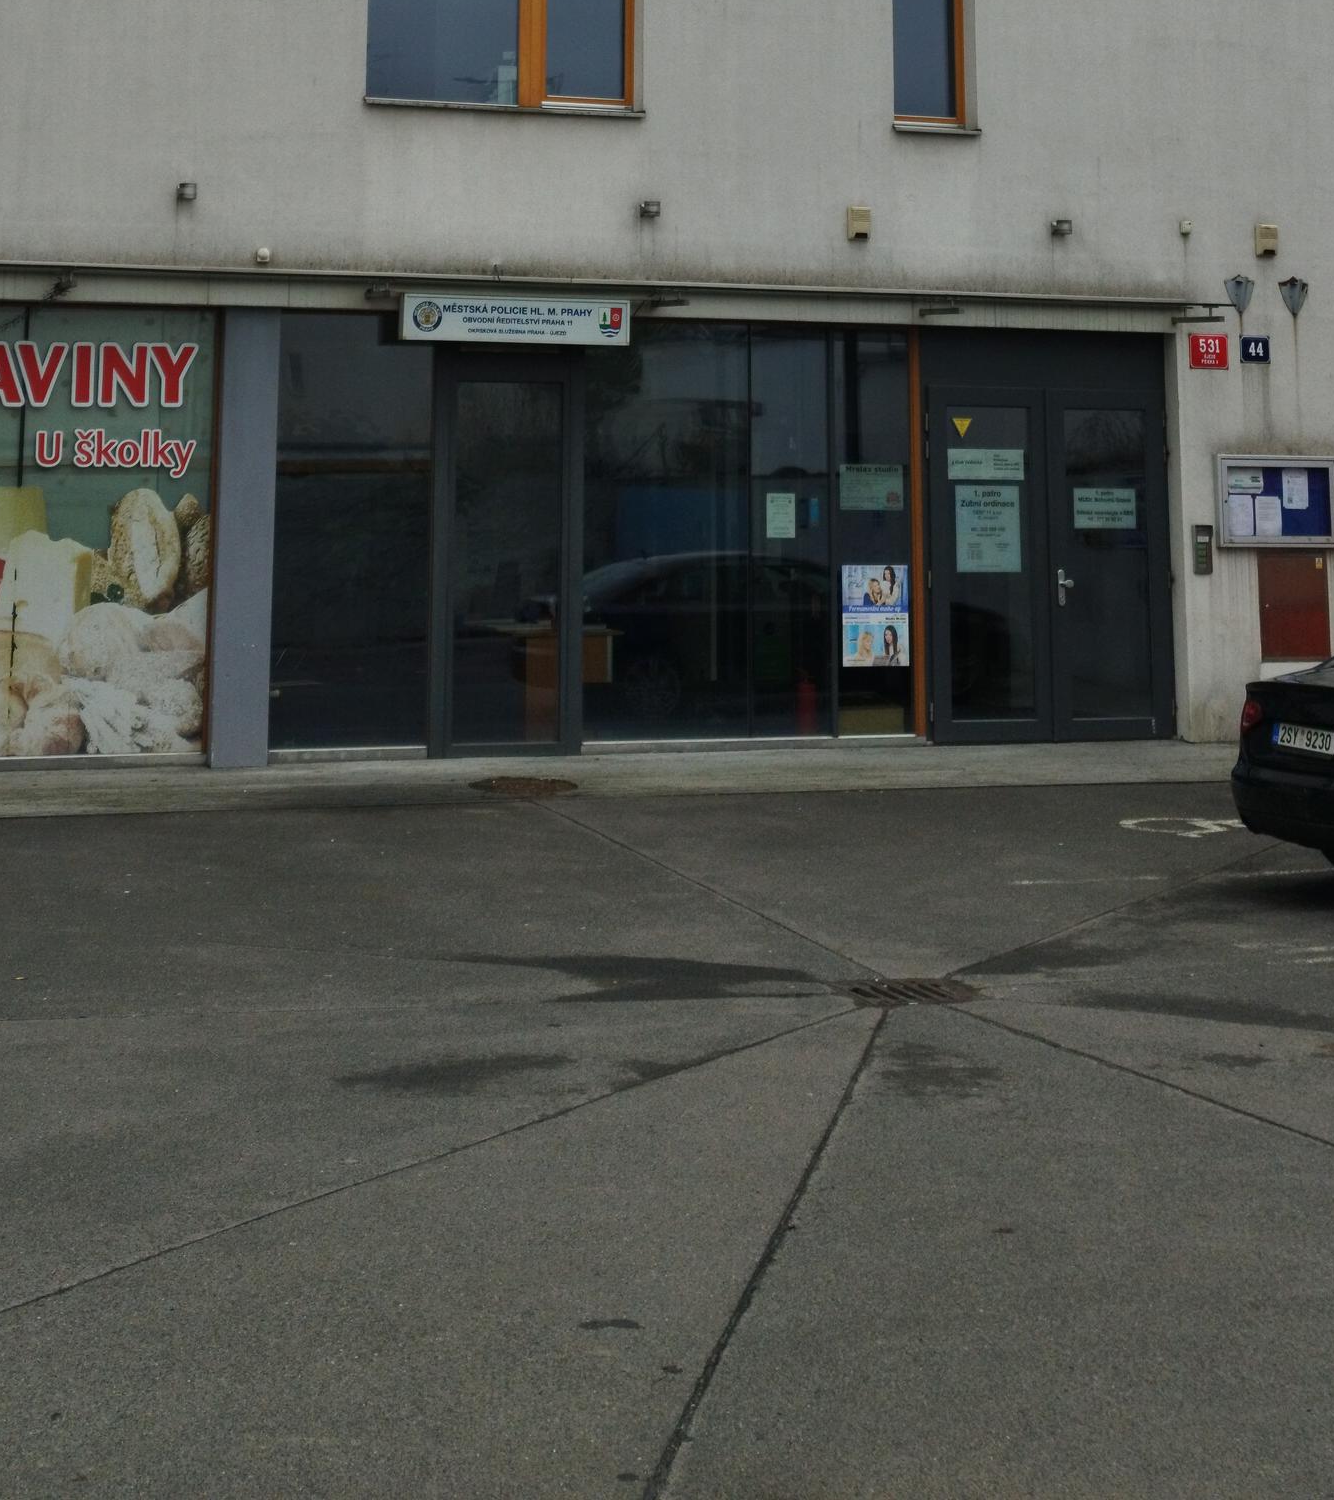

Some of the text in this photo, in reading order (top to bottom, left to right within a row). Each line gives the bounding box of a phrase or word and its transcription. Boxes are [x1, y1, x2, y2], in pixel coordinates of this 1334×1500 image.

[442, 302, 593, 317] MĚSTSKÁ POLICIE HL. M. PRAHY
[462, 316, 495, 324] OBVODNÍ
[496, 316, 540, 325] ŘEDITELSTVÍ
[1198, 338, 1220, 354] 531
[1248, 342, 1264, 357] 44
[35, 428, 197, 479] U školky
[982, 490, 1002, 498] patro
[960, 499, 1015, 508] Zubní ordinace
[1279, 725, 1332, 751] 2SY 9230
